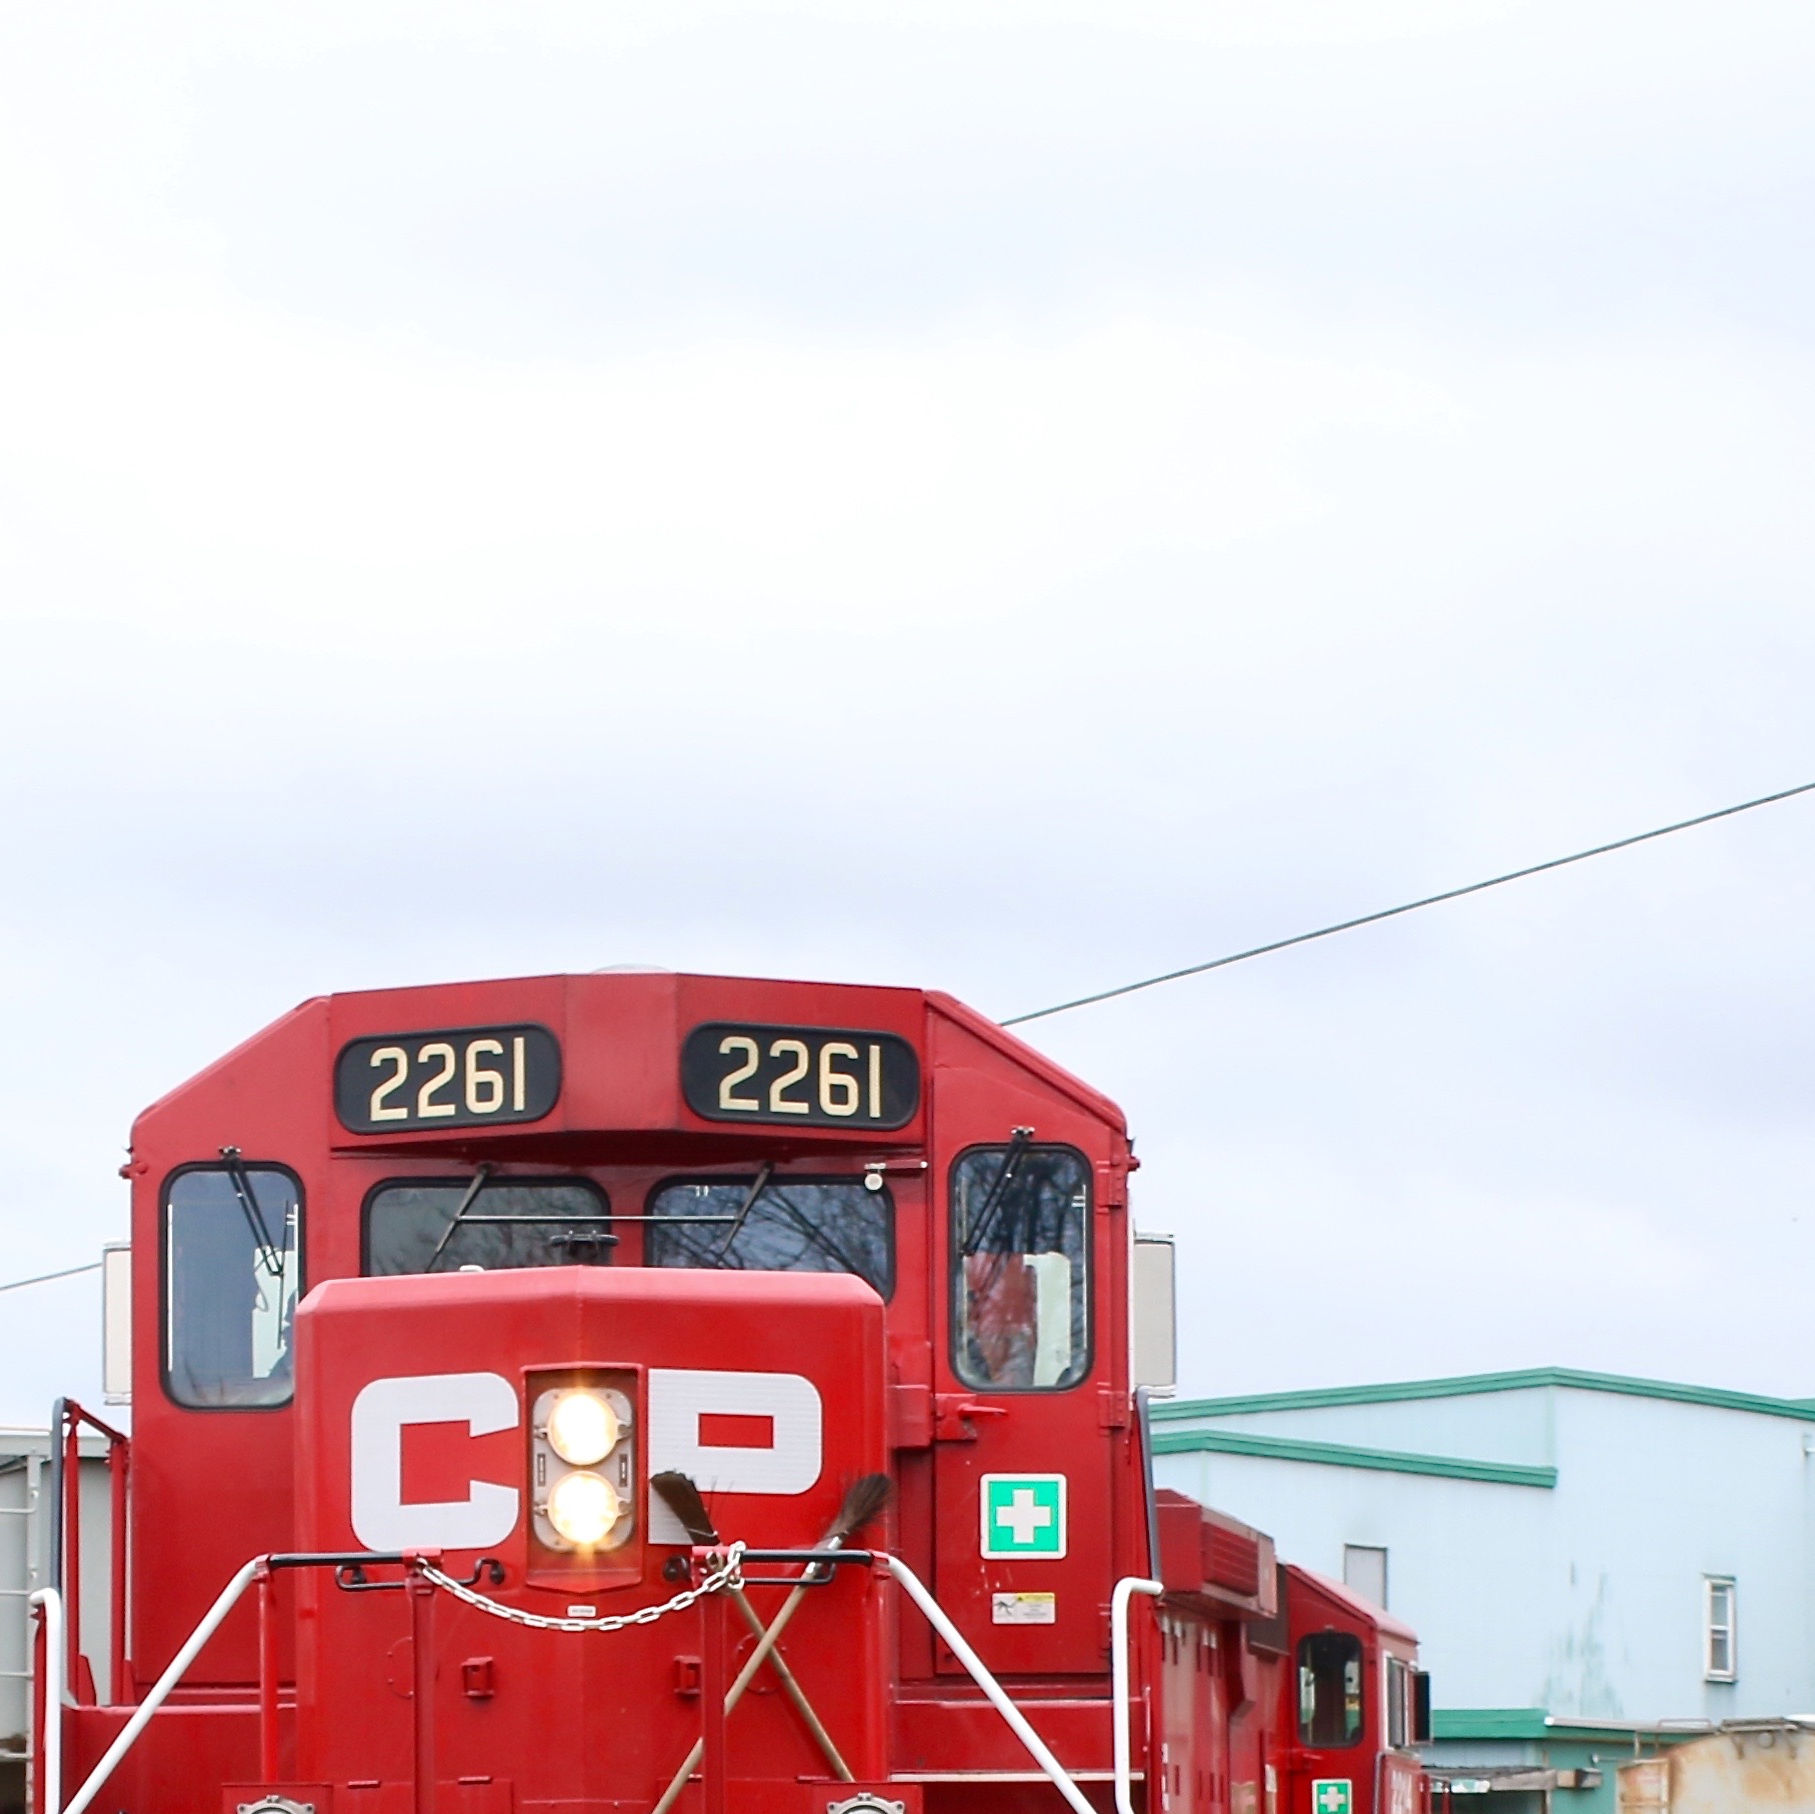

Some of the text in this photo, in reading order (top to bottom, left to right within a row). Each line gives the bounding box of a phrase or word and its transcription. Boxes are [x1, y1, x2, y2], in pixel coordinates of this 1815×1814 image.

[369, 1036, 525, 1122] 2261
[718, 1035, 881, 1119] 2261
[350, 1368, 823, 1552] CP
